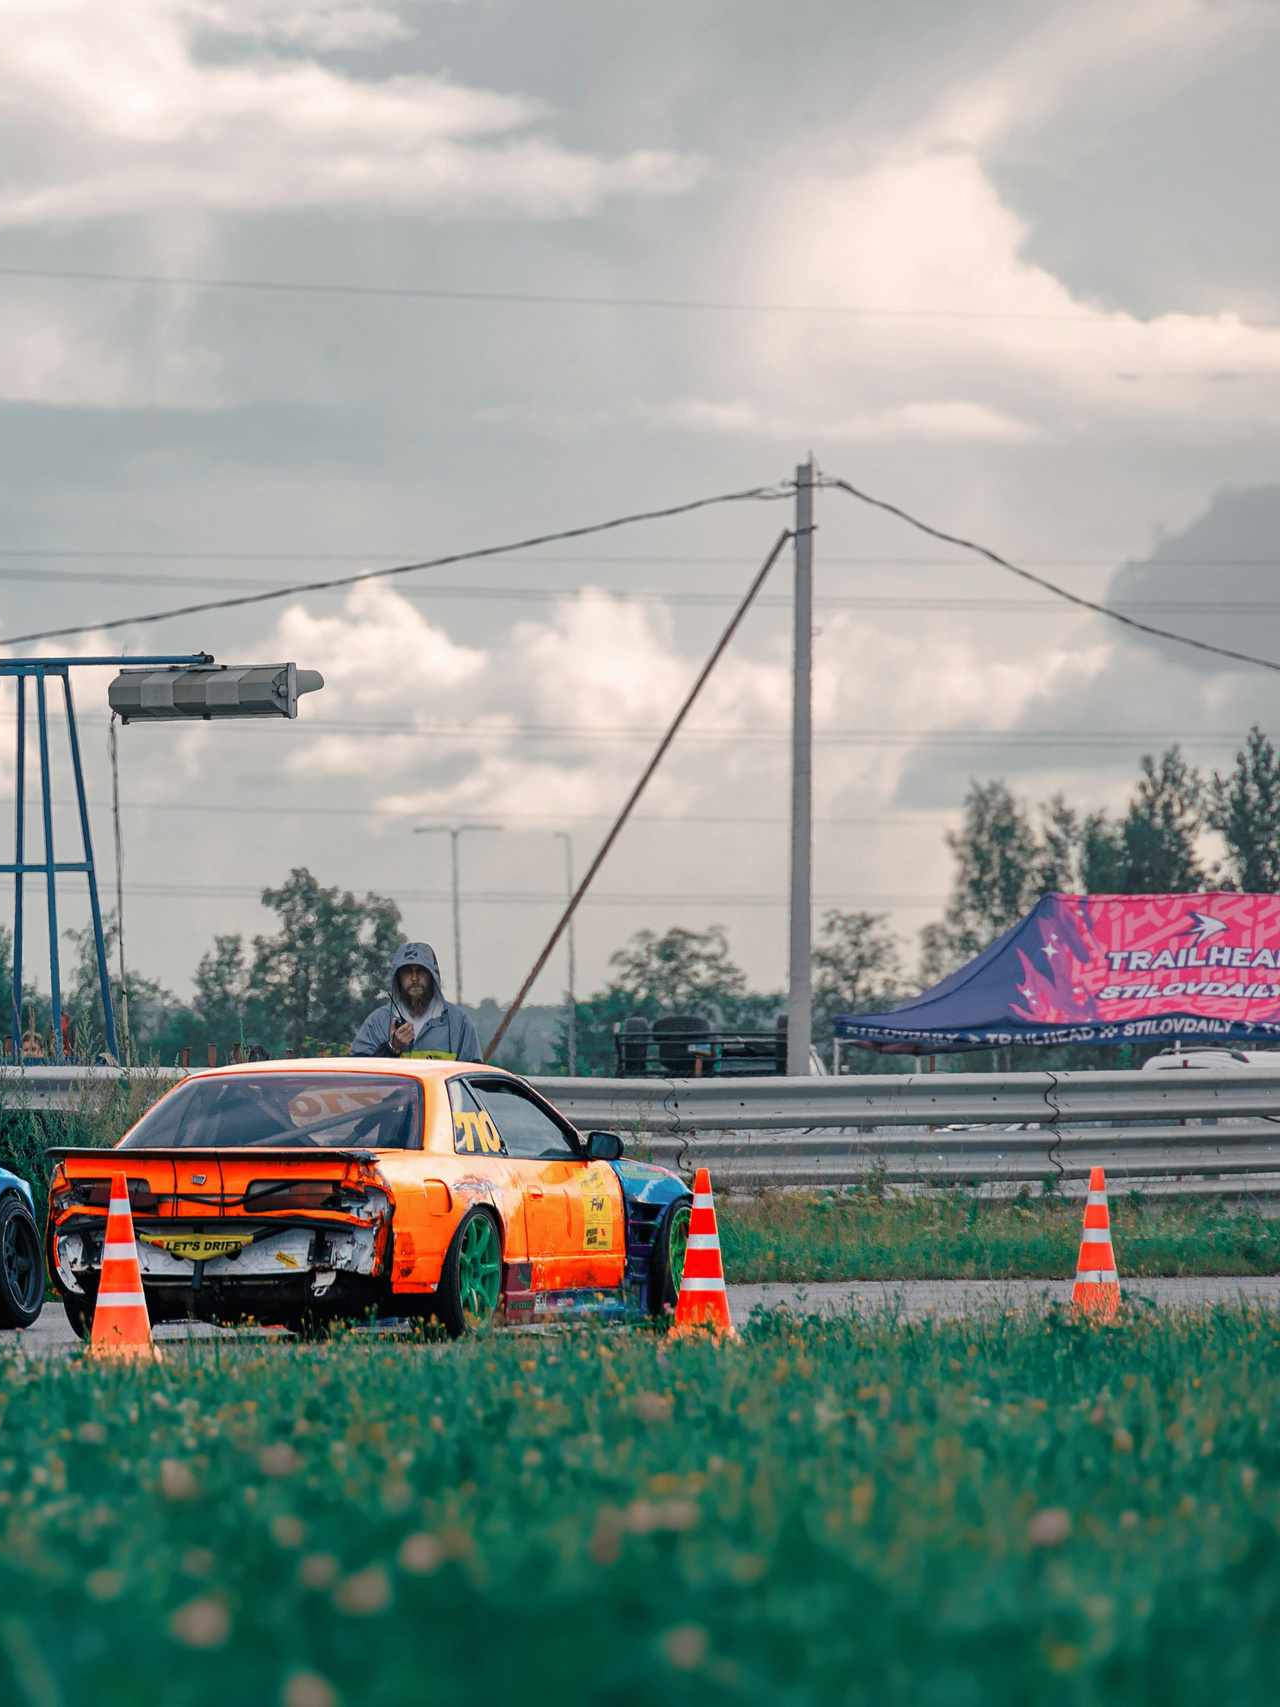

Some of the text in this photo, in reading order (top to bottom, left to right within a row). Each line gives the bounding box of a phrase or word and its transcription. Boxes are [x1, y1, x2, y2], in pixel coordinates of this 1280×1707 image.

[1107, 946, 1280, 970] TRAILHEA
[1123, 1018, 1235, 1036] STILOVDAILY
[452, 1110, 501, 1152] 710
[165, 1241, 200, 1251] LET'S
[203, 1240, 242, 1251] DRIFT
